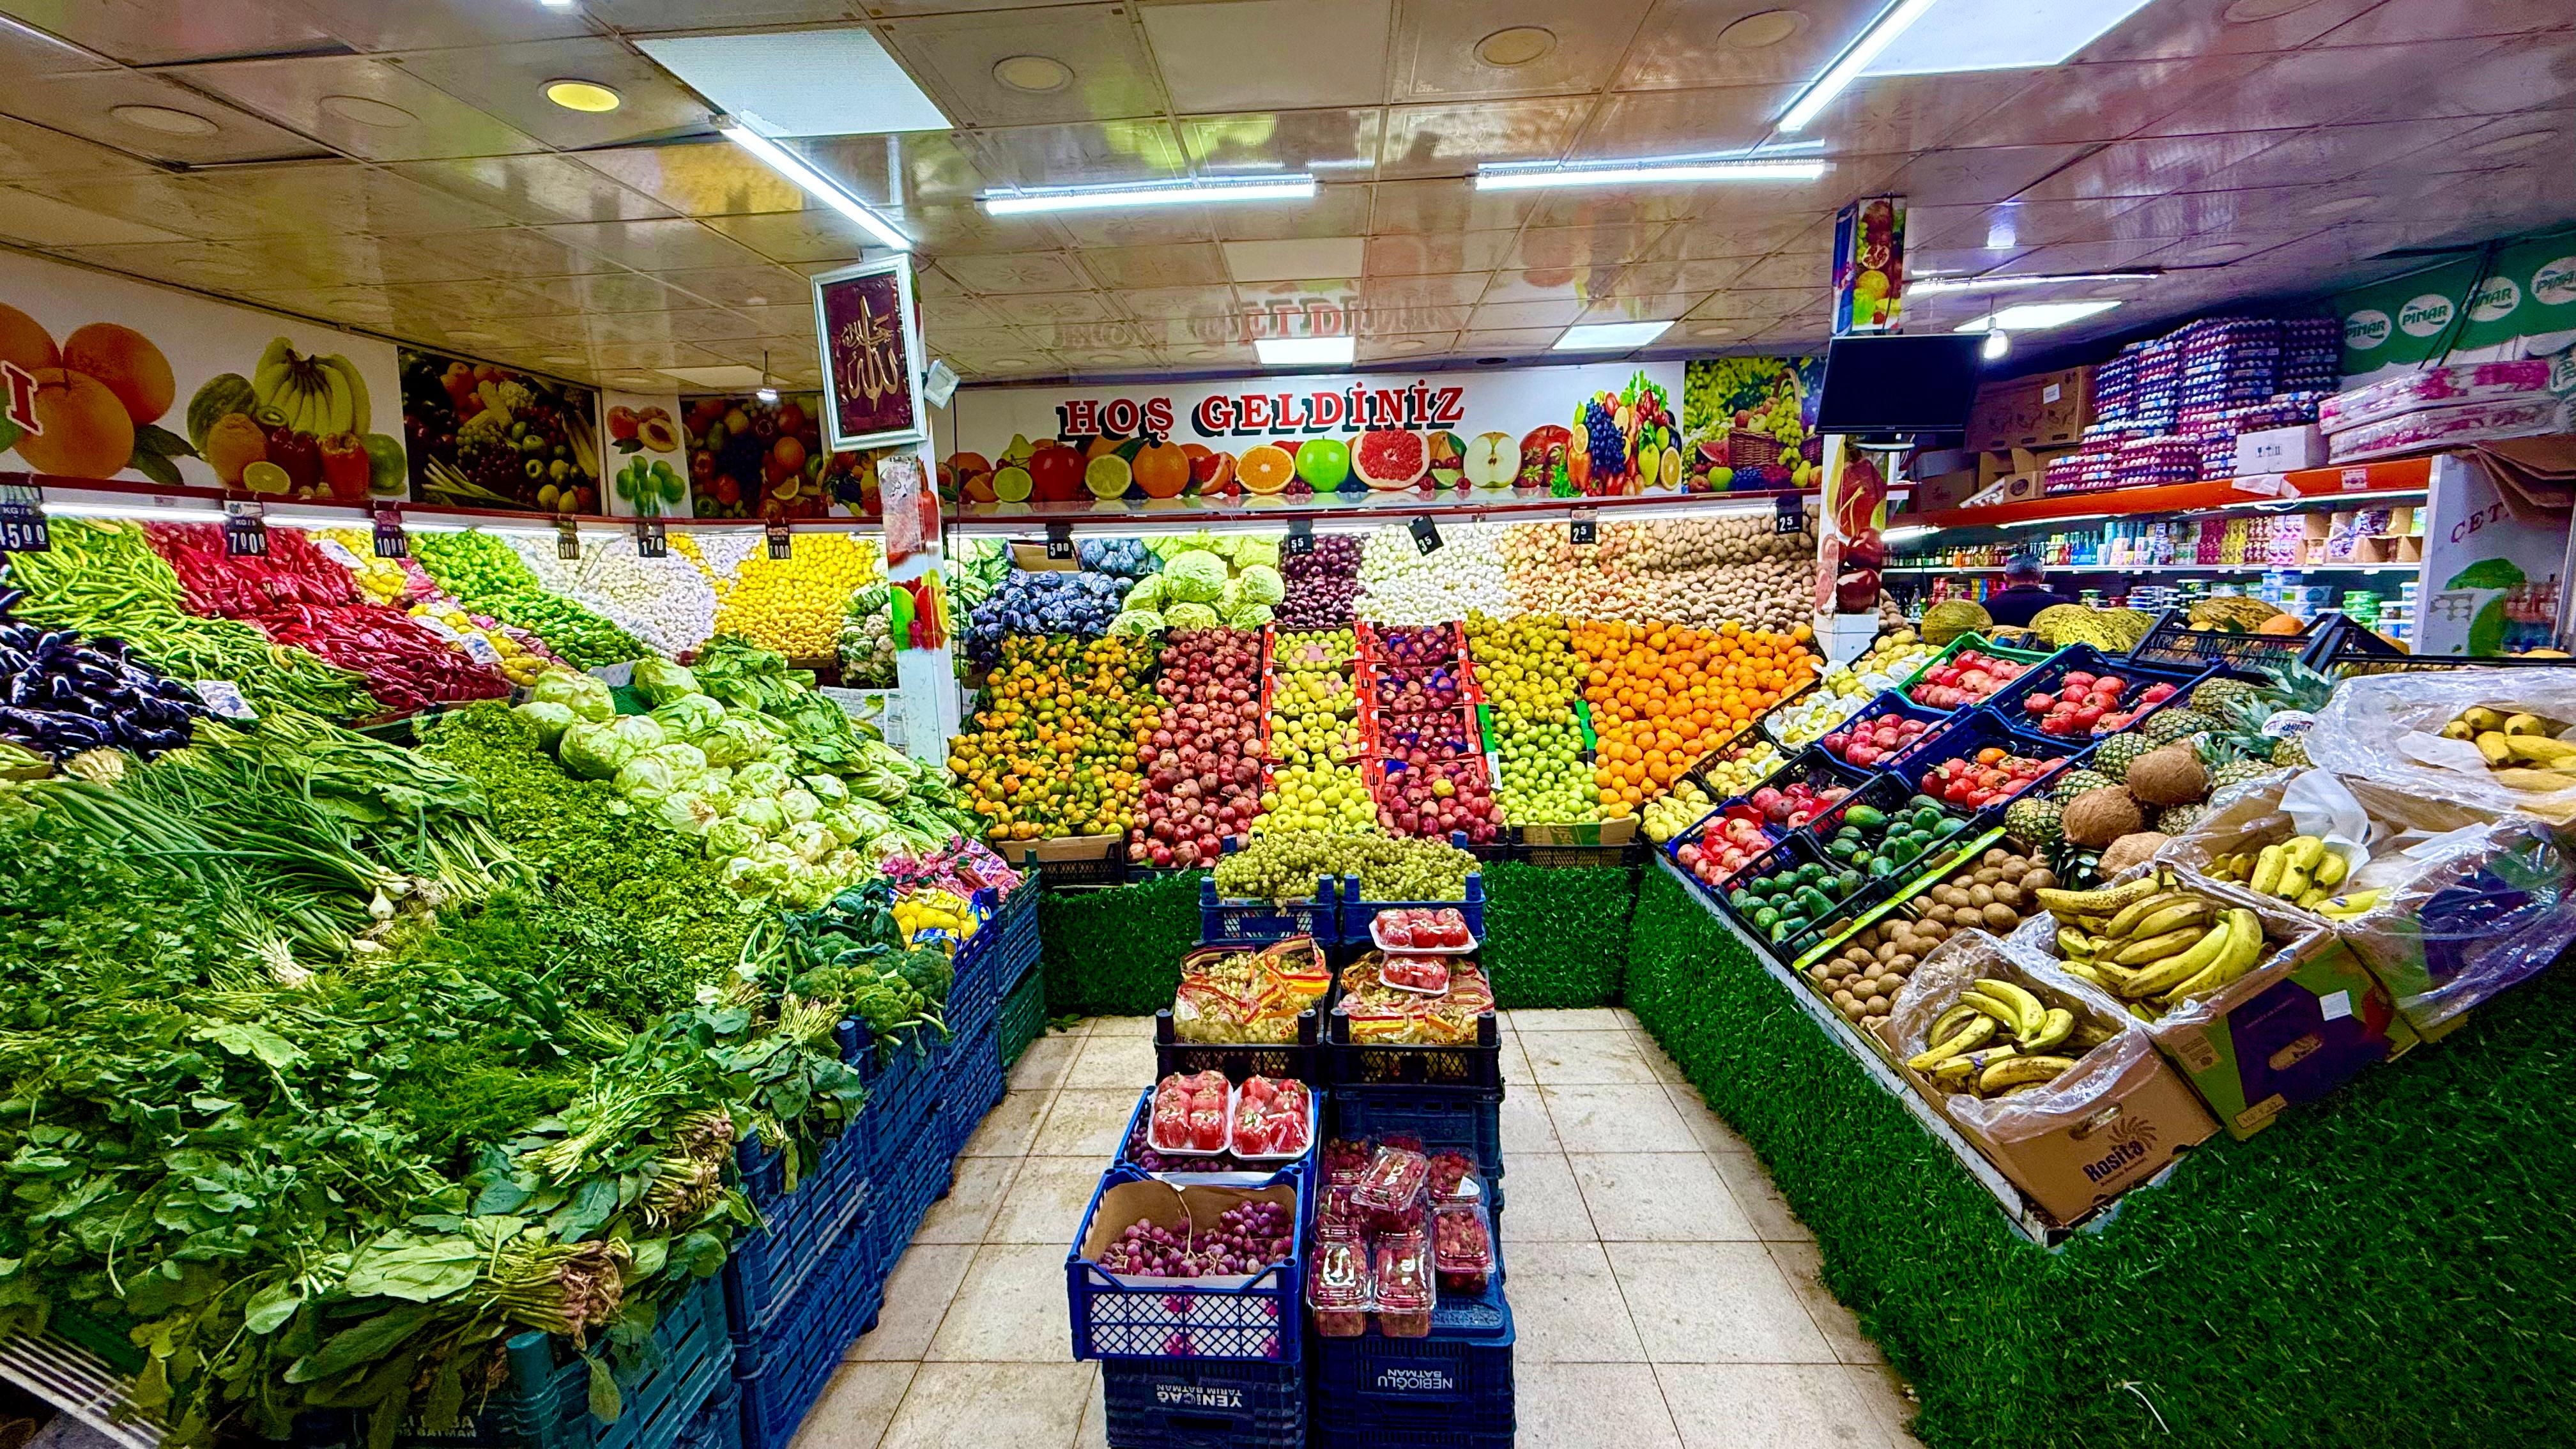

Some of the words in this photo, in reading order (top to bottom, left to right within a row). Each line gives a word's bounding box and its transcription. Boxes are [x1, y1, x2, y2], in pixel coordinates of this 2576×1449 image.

[2471, 287, 2513, 309] INAR
[1063, 396, 1175, 441] HOŞ
[1199, 378, 1466, 433] GELDİNİZ
[2450, 501, 2510, 544] CET
[2082, 1139, 2146, 1183] Rosita
[1387, 1368, 1442, 1378] BATMAN
[1156, 1384, 1204, 1394] BATMAN
[1206, 1387, 1243, 1397] TARIM
